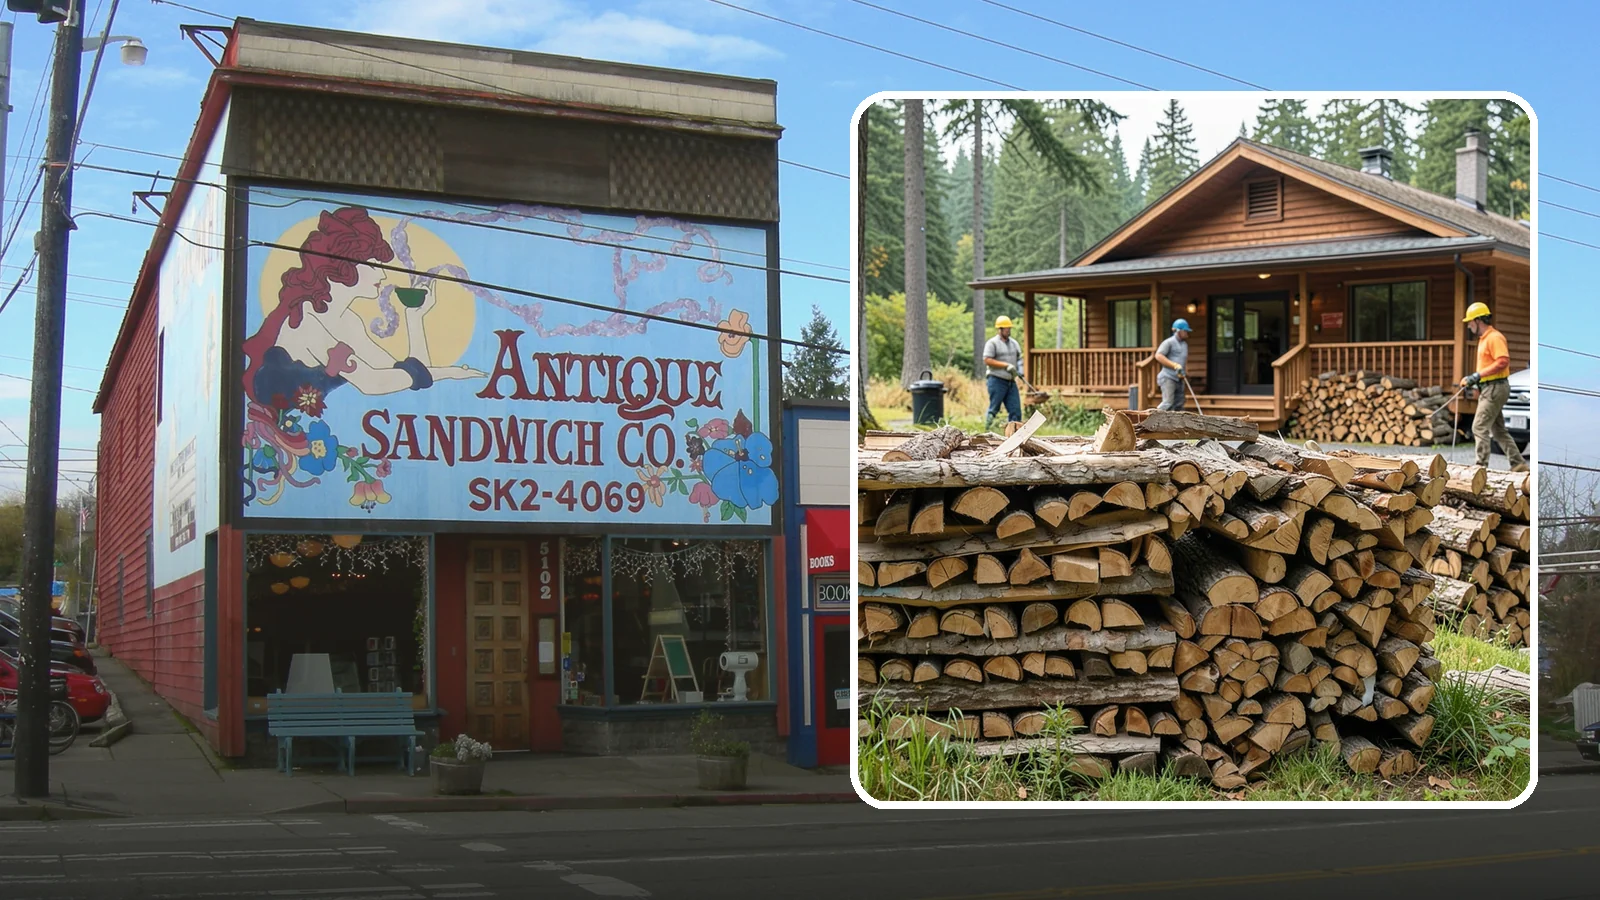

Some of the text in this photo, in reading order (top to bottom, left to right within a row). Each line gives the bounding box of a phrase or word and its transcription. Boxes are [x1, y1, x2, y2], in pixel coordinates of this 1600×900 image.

[476, 329, 723, 421] ANTIQUE
[361, 408, 685, 468] SANDWICH CO.
[468, 477, 646, 513] SK2-4069
[540, 541, 552, 600] 5102
[809, 555, 835, 569] BOOKS
